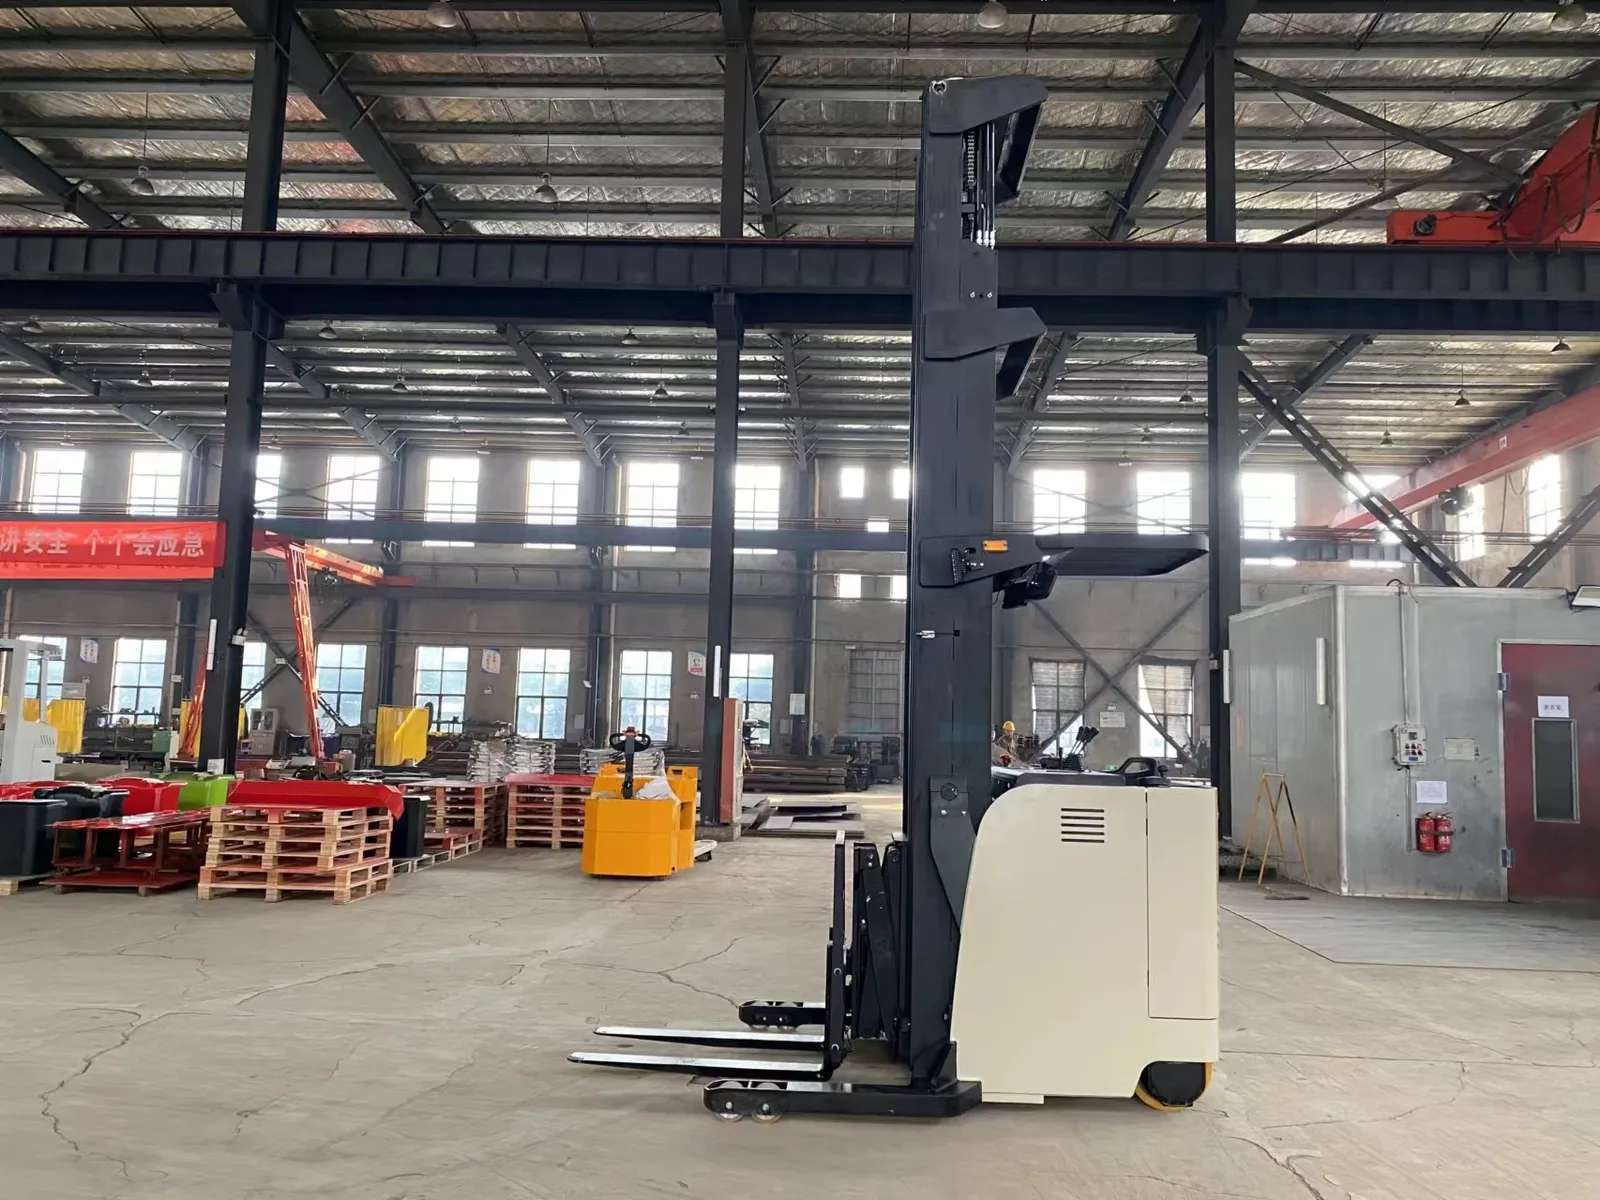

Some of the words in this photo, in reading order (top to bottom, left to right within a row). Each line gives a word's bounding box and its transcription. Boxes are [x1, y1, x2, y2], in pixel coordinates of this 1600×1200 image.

[83, 527, 204, 557] 个个会应急
